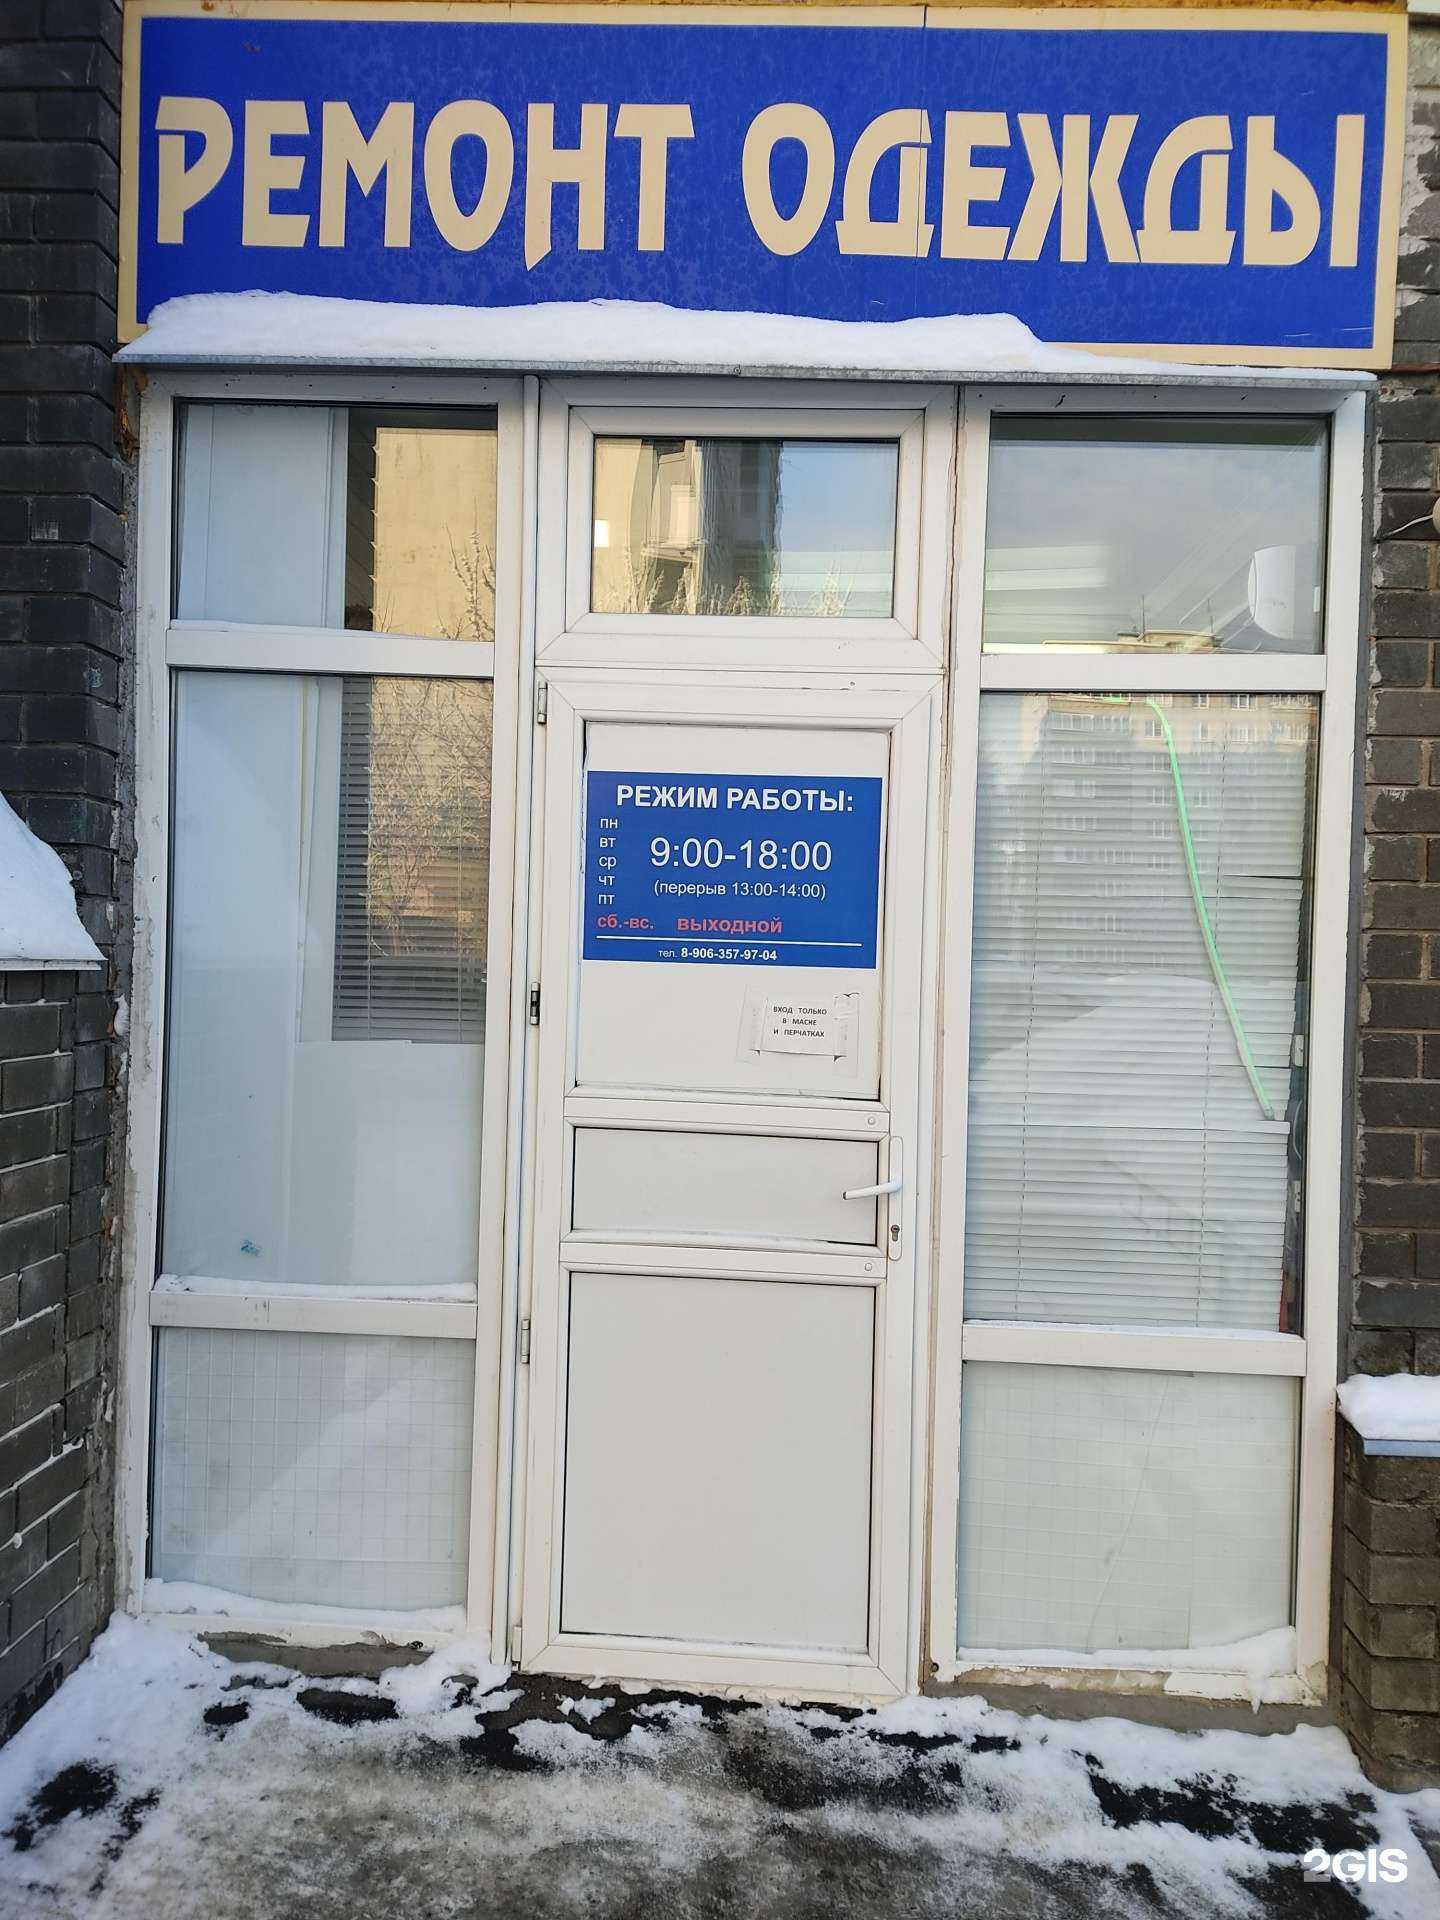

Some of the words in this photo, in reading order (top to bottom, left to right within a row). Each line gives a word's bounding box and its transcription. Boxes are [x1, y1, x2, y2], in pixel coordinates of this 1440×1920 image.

[155, 96, 695, 271] РЕМОНТ
[741, 102, 1365, 267] ОДЕЖДЫ
[616, 784, 718, 809] РЕЖИМ
[726, 787, 855, 812] РАБОТЫ:
[650, 837, 832, 871] 9:00-18:00
[654, 880, 727, 897] (перерыв
[731, 882, 826, 900] 13:00-14:00)
[597, 913, 655, 930] сб.-вс.
[658, 949, 678, 959] тел.
[680, 947, 778, 961] 8-906-357-97-04
[773, 1006, 793, 1014] ВХОД
[798, 1007, 827, 1015] ТОЛЬКО
[792, 1018, 817, 1026] МАСКЕ
[784, 1029, 825, 1037] ПЕРЧАТКАХ
